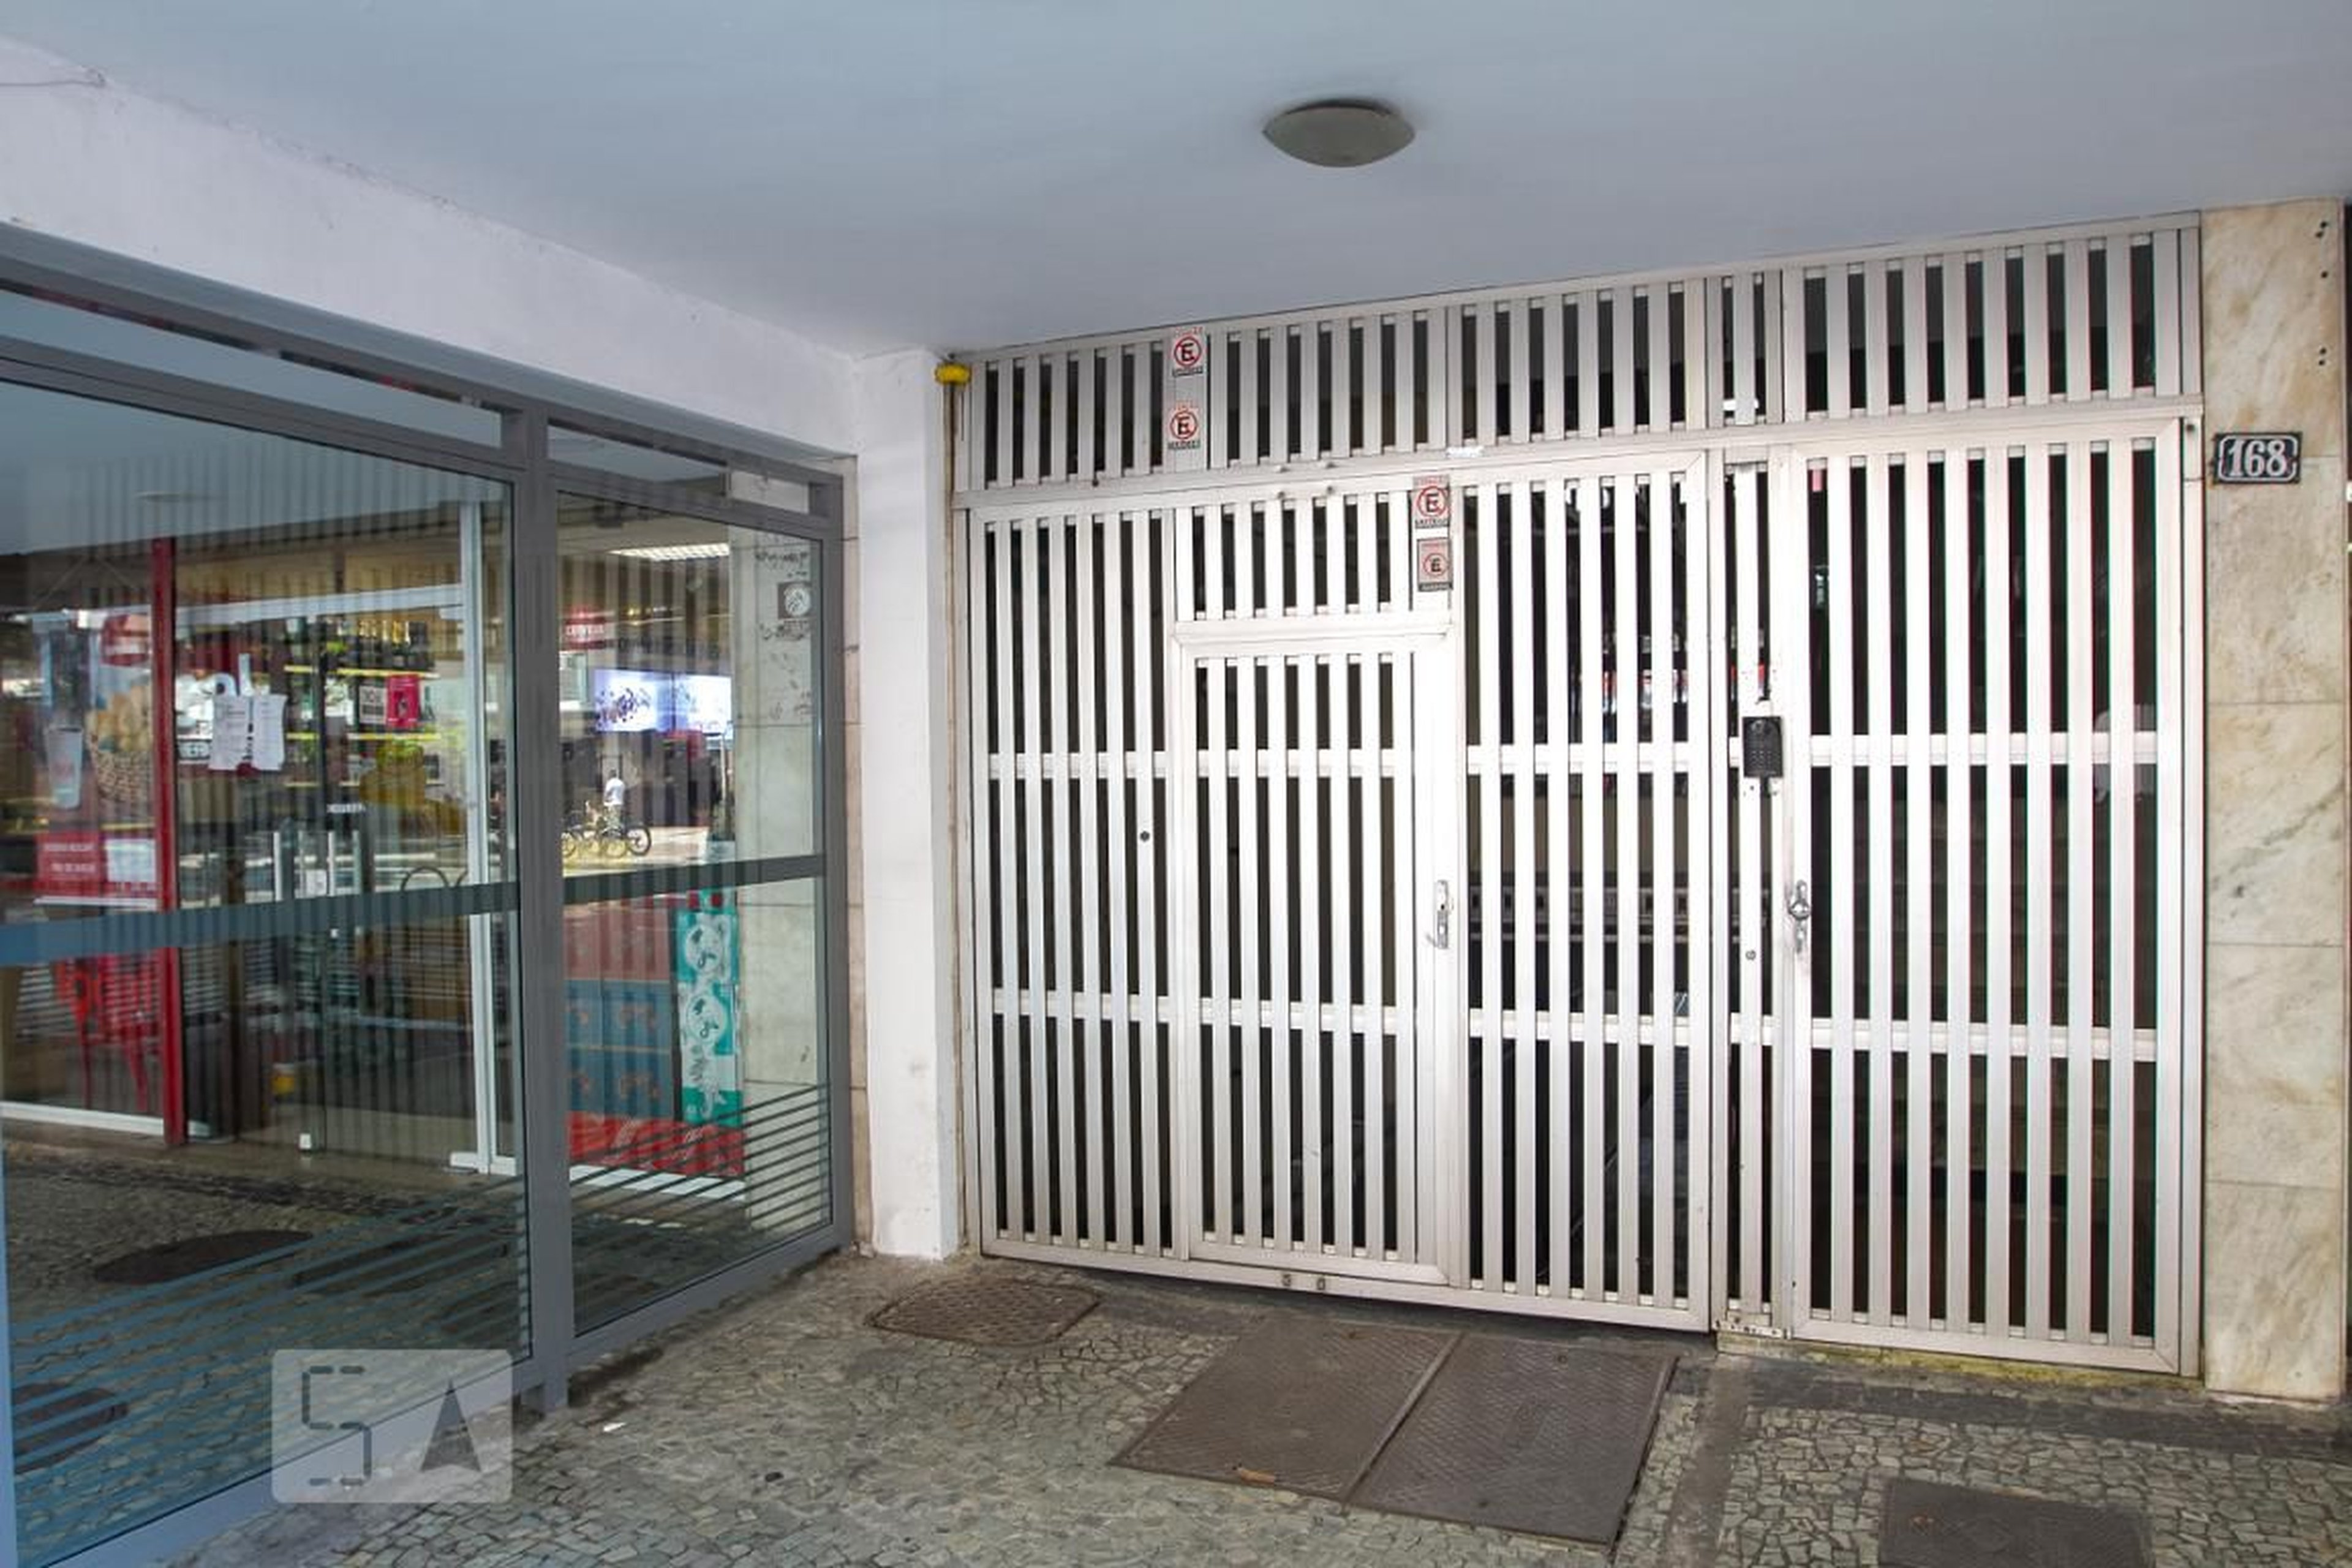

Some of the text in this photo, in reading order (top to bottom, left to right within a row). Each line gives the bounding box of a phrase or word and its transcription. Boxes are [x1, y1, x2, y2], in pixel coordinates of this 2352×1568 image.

[1182, 343, 1194, 361] E
[1178, 417, 1190, 435] E
[2228, 440, 2287, 477] 168
[1426, 493, 1439, 512] E
[1431, 557, 1441, 572] E
